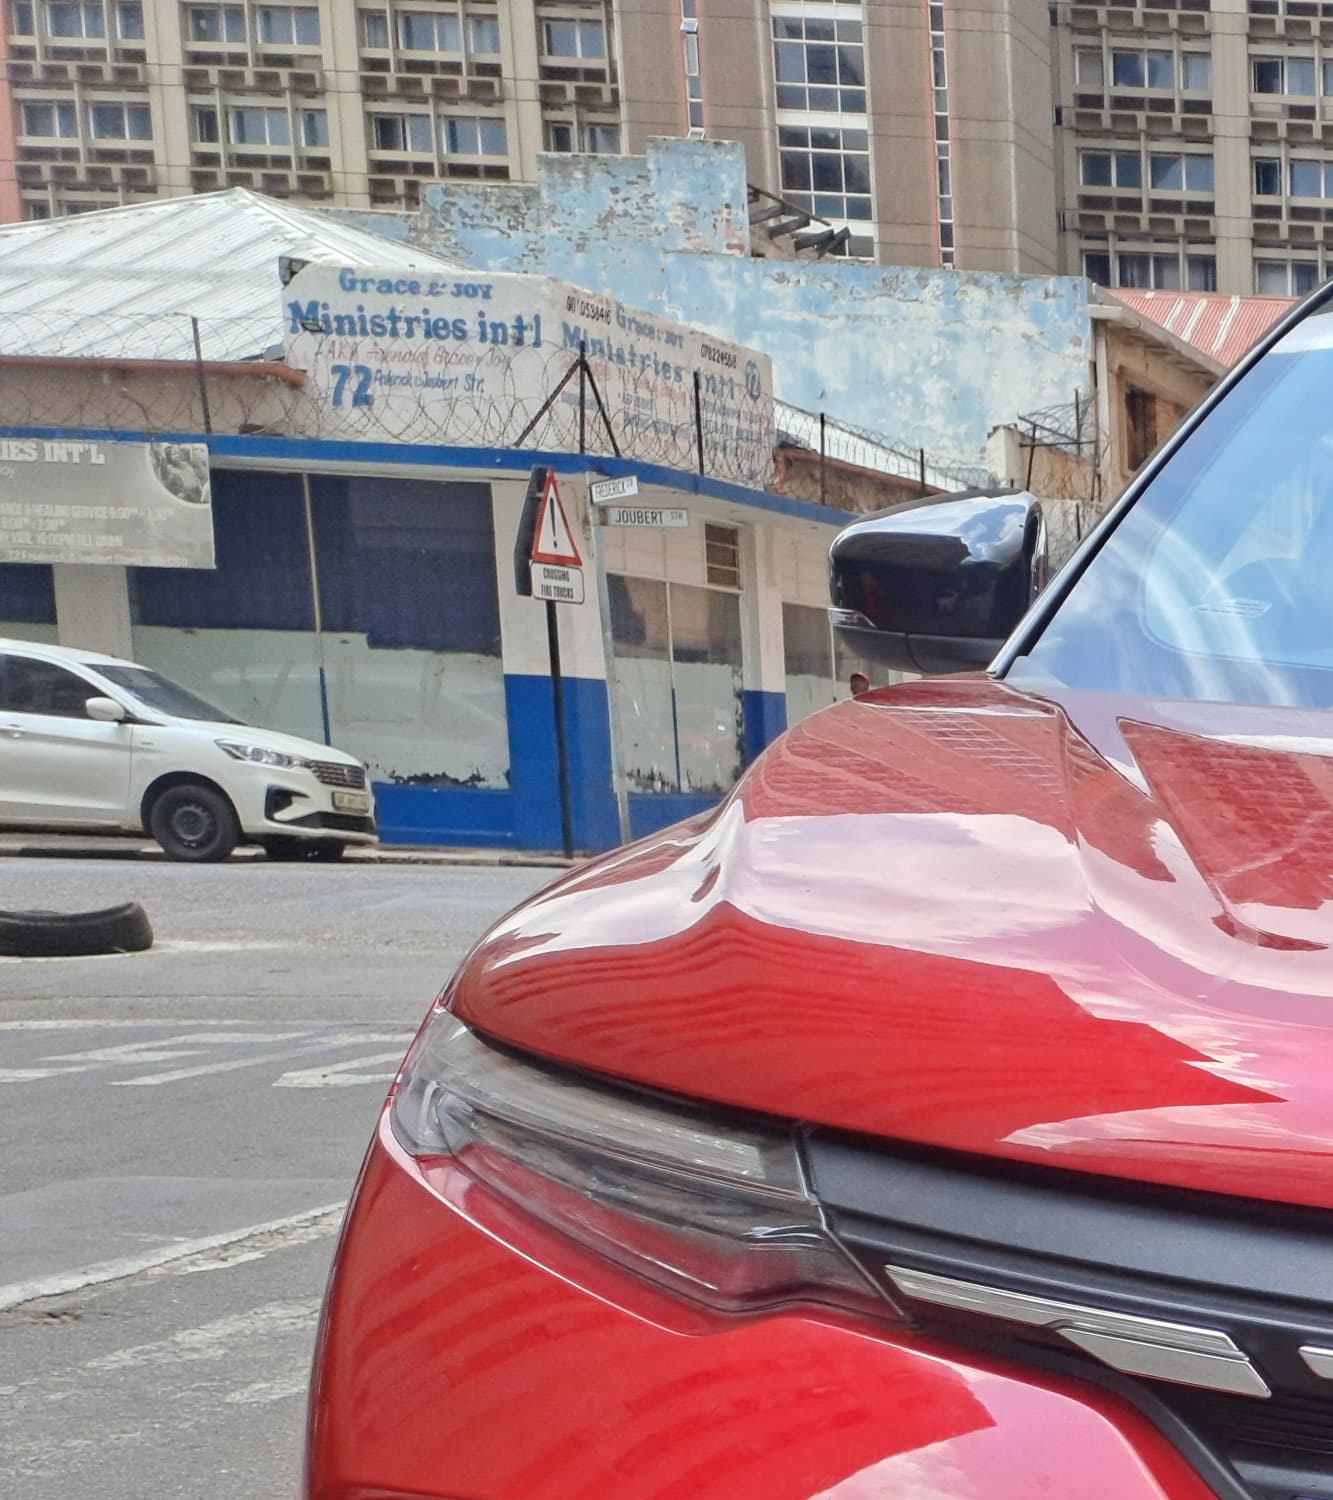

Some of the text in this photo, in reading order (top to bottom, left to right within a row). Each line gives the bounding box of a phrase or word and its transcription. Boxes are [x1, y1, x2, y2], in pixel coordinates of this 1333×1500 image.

[339, 268, 421, 294] Grace
[451, 282, 493, 299] JOY
[288, 300, 467, 341] Ministries
[331, 364, 375, 408] 72
[44, 442, 105, 465] INT'L
[616, 509, 664, 525] JOUBERT
[543, 567, 570, 582] CROSSING
